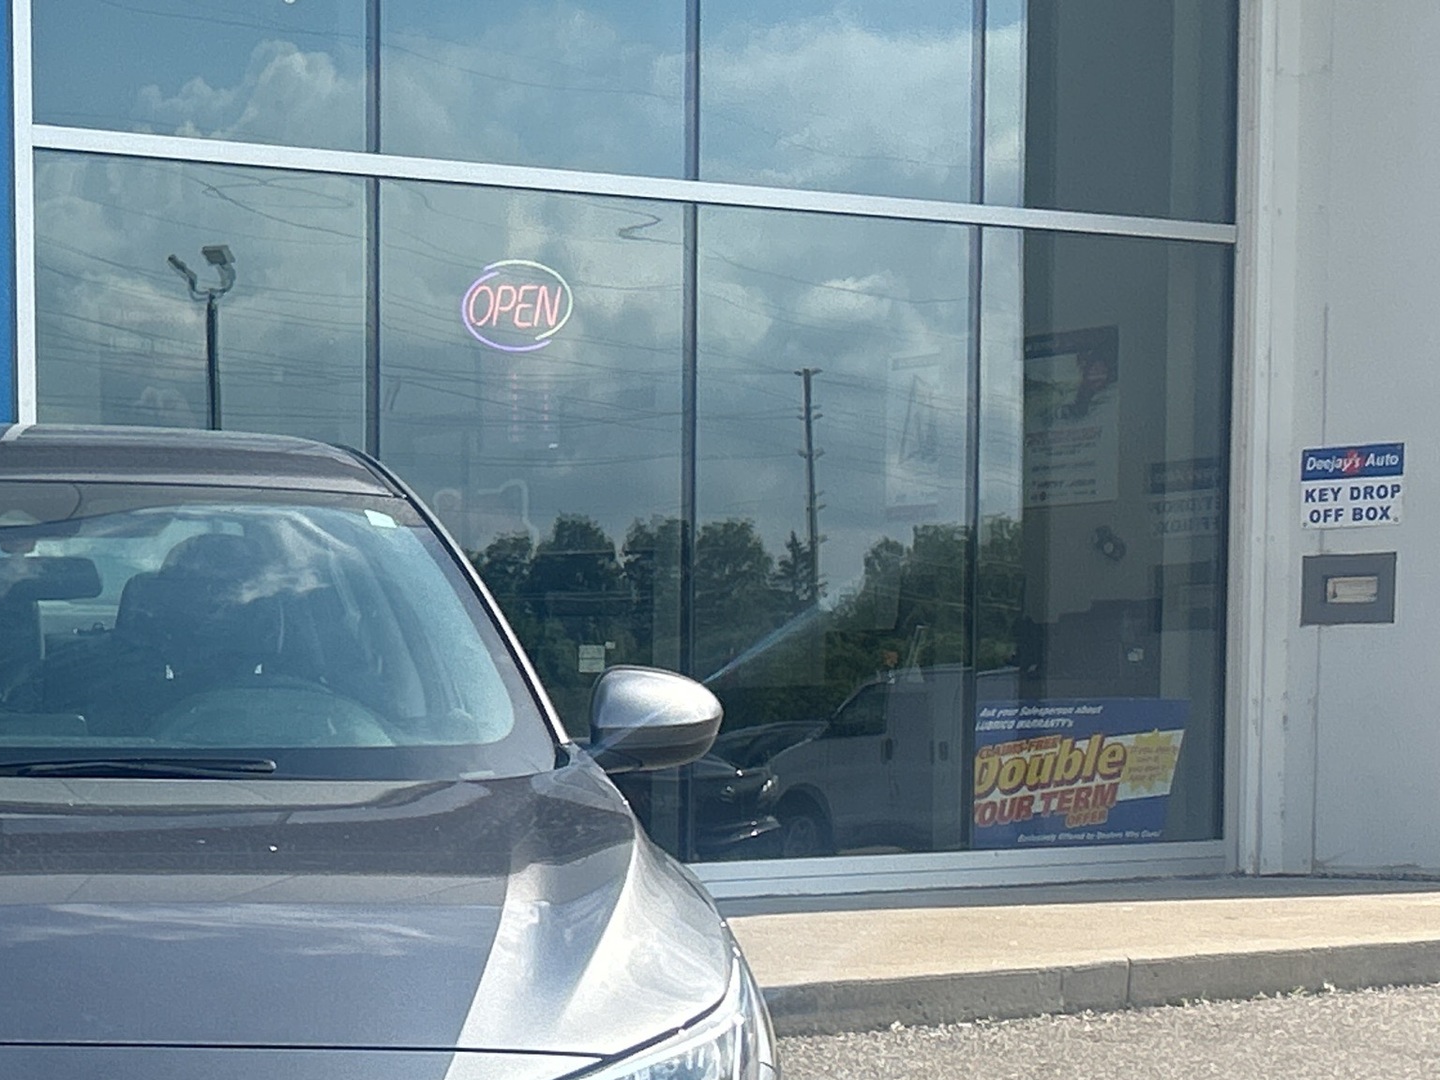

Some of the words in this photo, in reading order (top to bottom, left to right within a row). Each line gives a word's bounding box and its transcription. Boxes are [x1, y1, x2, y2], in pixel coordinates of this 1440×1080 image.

[469, 285, 562, 328] OPEN
[1306, 454, 1361, 472] Deejay's
[1365, 453, 1399, 467] Auto
[1304, 487, 1342, 503] KEY
[1349, 484, 1401, 501] DROP
[1309, 508, 1344, 524] OFF
[1352, 506, 1391, 521] BOX
[974, 734, 1127, 798] Double
[1041, 783, 1119, 817] TERM
[1066, 808, 1108, 828] OFFER
